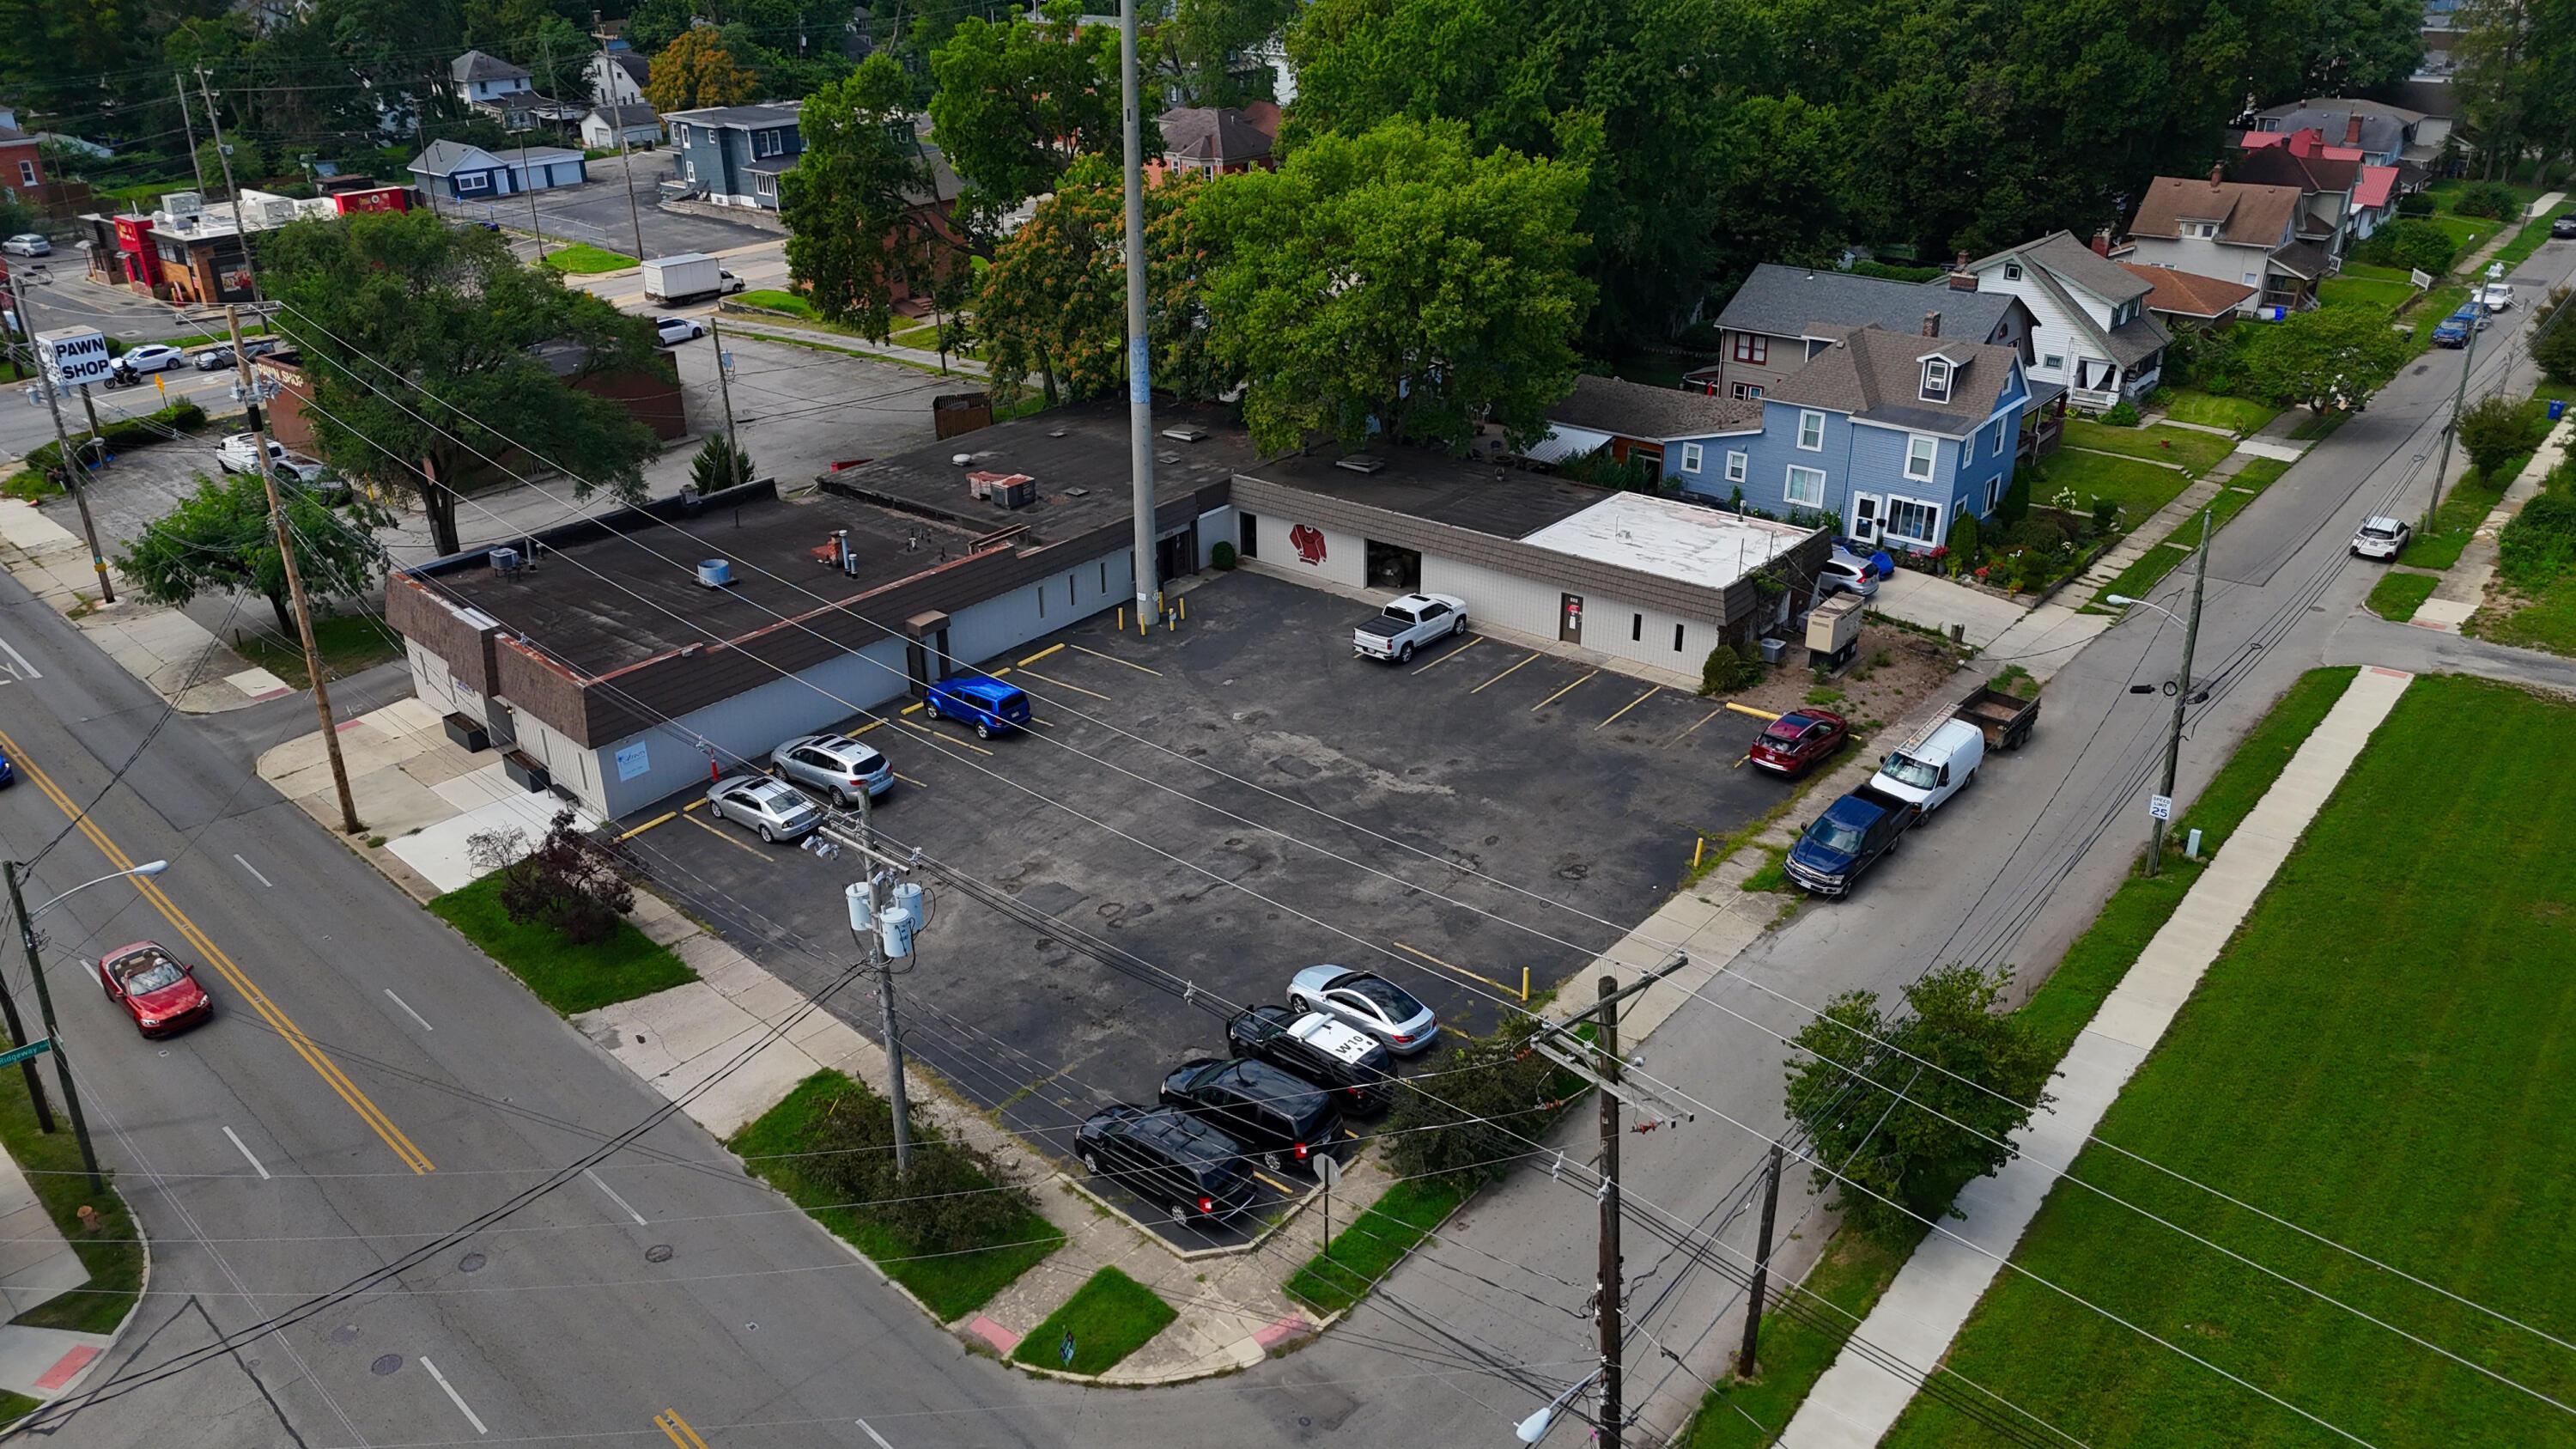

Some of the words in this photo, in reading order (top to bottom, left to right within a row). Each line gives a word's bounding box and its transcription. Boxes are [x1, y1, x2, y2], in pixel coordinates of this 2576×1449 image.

[55, 338, 105, 358] PAWN
[62, 359, 110, 380] SHOP
[2154, 796, 2170, 805] SPEED
[2152, 807, 2167, 818] 25
[1335, 1035, 1364, 1054] W10
[0, 1047, 38, 1065] Ridgeway
